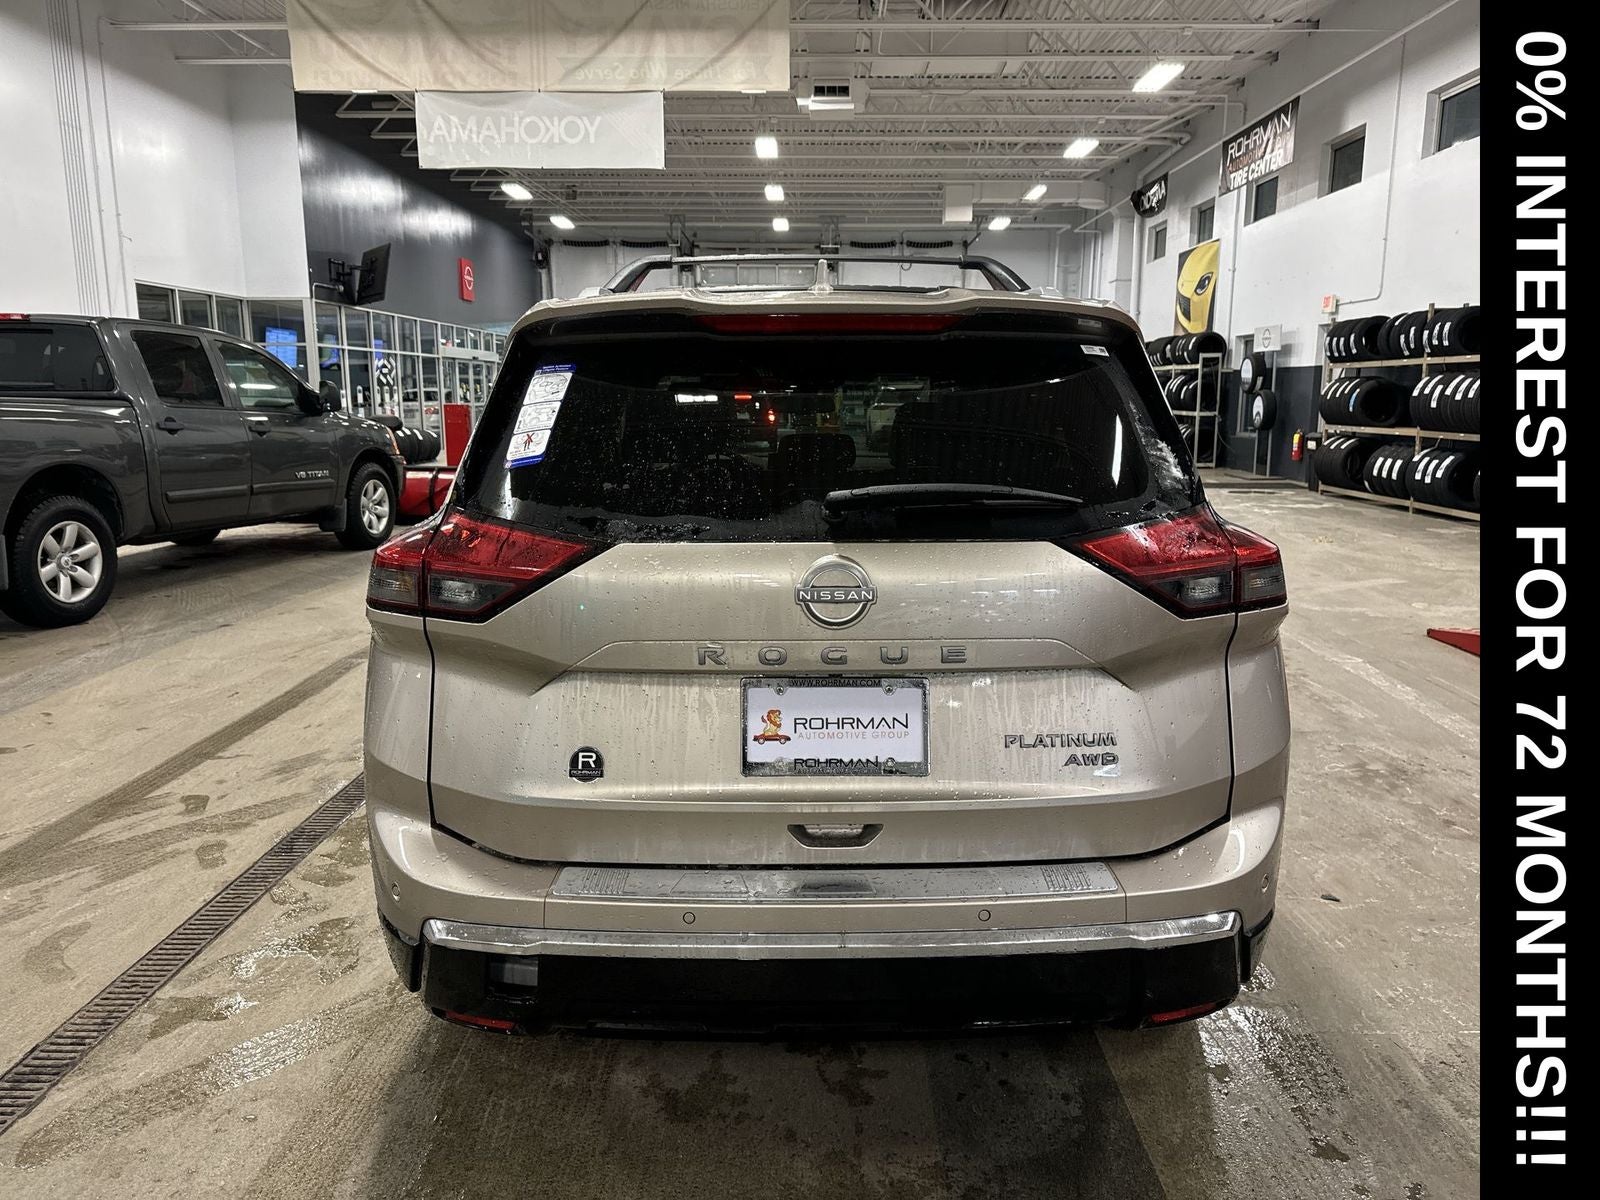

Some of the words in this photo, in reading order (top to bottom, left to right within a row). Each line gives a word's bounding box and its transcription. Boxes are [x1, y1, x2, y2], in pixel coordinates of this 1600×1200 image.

[1226, 103, 1293, 167] ROHRMAN
[1230, 165, 1249, 191] TIRE
[1248, 147, 1284, 182] CENTER
[799, 590, 874, 601] NISSAN
[697, 645, 968, 666] ROGUE
[791, 679, 881, 687] WWW.ROHRMAN.COM
[793, 713, 909, 734] ROHRMAN
[798, 731, 867, 740] AUTOMOTIVE
[871, 731, 910, 740] GROUP
[1004, 732, 1118, 749] PLATINUM
[578, 752, 597, 770] R
[793, 755, 879, 770] ROHRMAN
[1064, 752, 1119, 766] AWD
